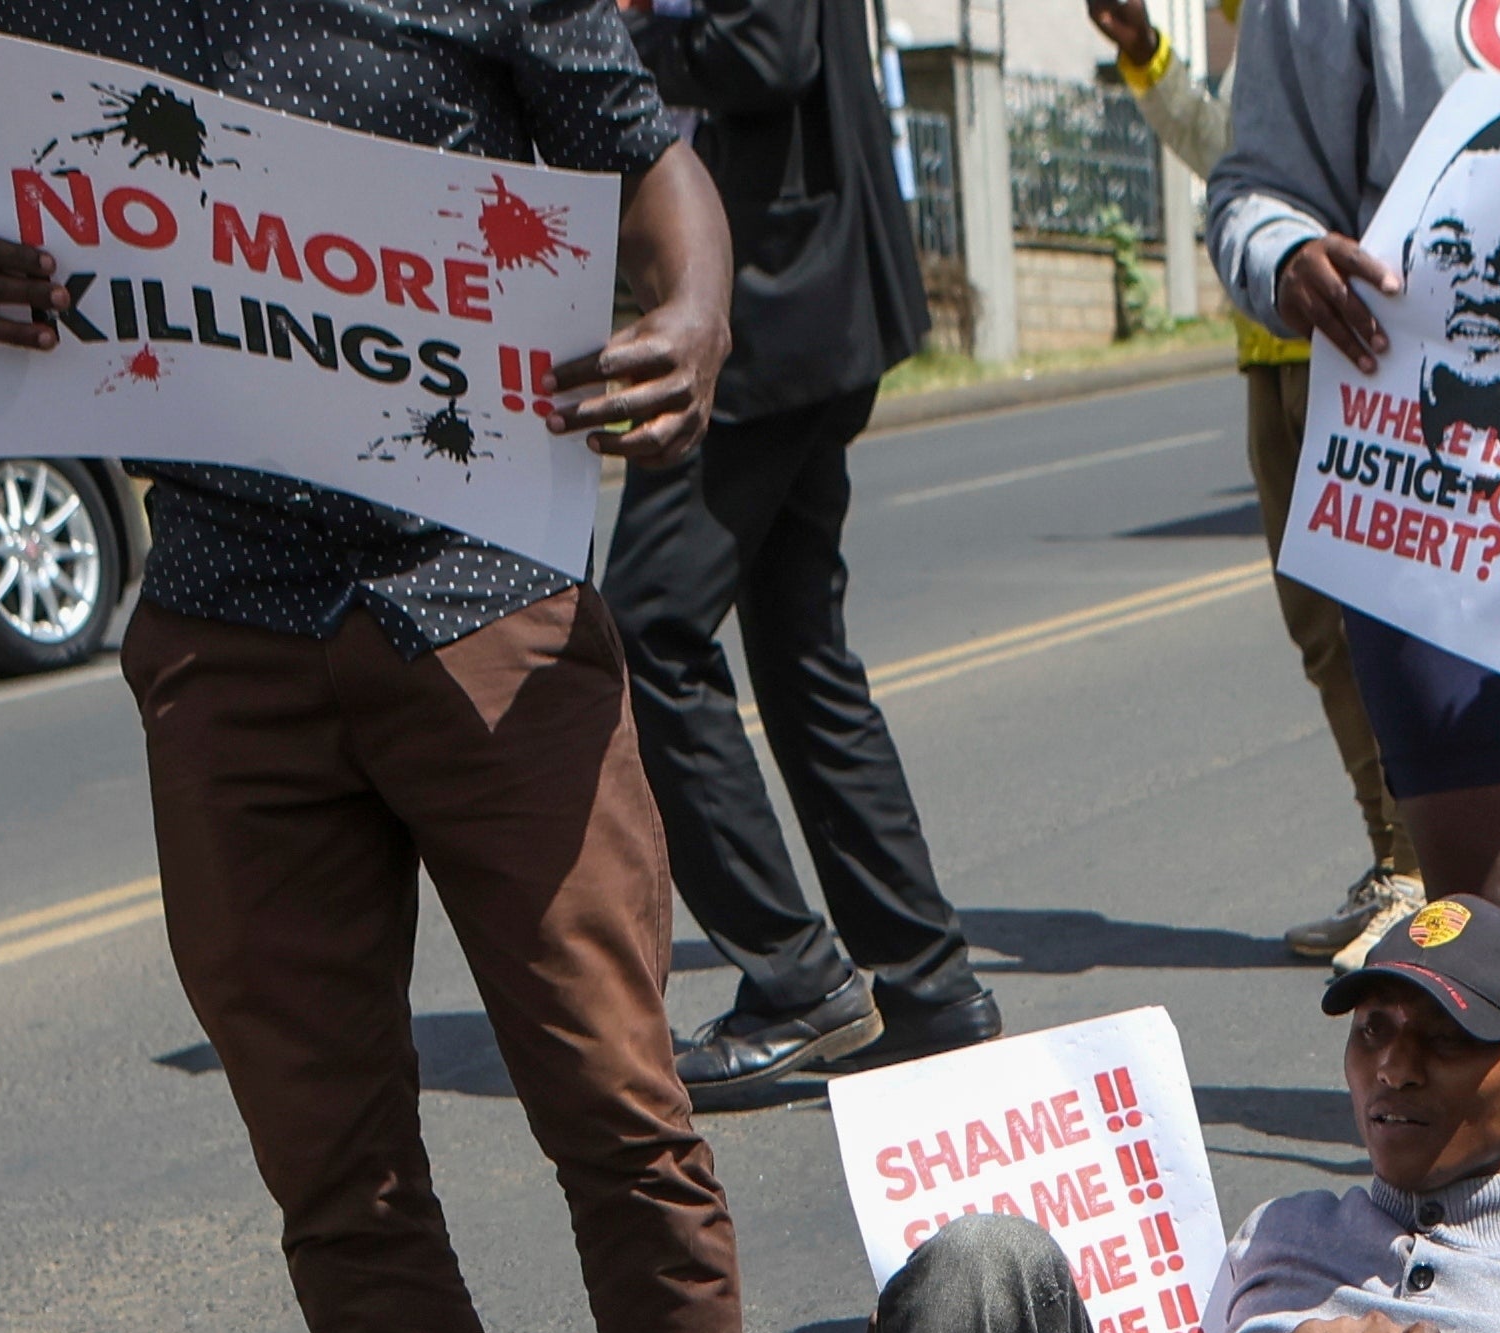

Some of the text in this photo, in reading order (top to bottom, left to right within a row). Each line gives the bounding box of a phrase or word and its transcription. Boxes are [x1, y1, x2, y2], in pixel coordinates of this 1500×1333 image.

[12, 167, 494, 323] NO MORE
[31, 271, 556, 416] KILLINGS !!
[1340, 382, 1472, 457] WHEE
[1317, 433, 1456, 510] JUSTICE
[876, 1066, 1144, 1202] SHAME !!
[1115, 1139, 1164, 1205] !!
[1138, 1211, 1184, 1277] !!
